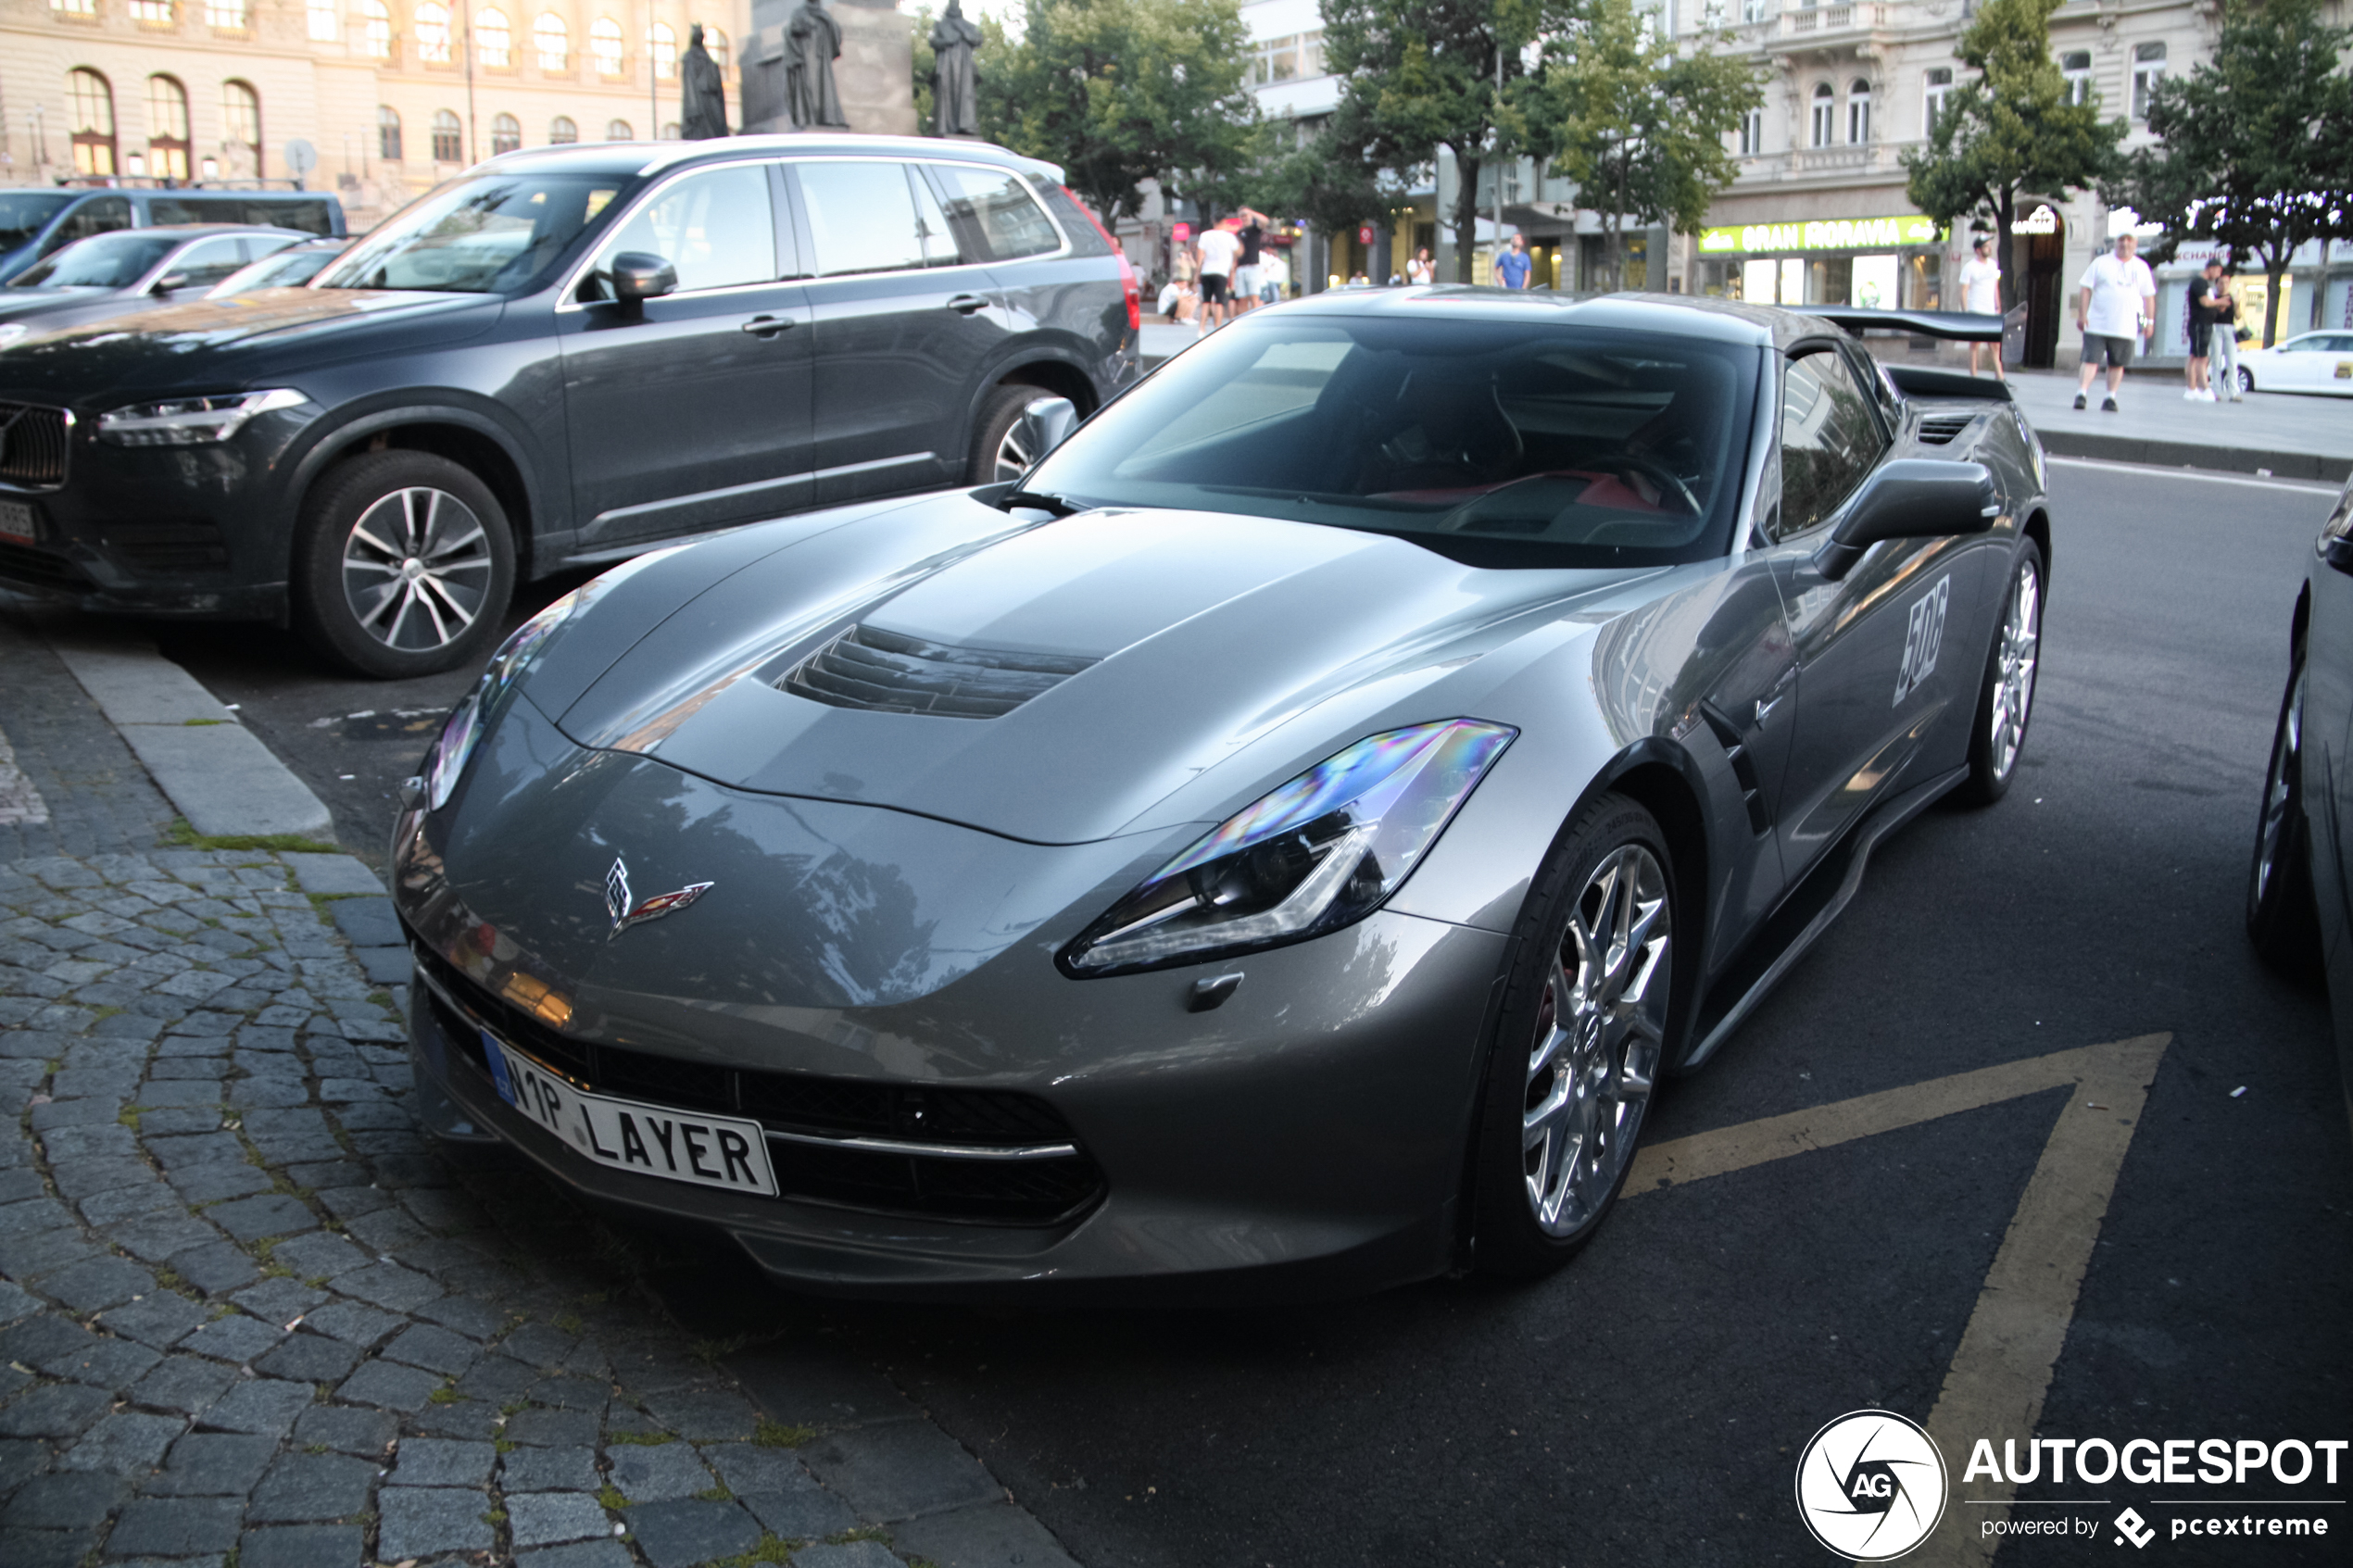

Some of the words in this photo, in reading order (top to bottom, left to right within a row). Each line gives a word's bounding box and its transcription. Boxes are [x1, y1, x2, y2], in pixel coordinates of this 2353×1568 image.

[1742, 224, 1799, 252] GRAN
[1805, 218, 1900, 249] MORAVIA
[1894, 575, 1949, 699] 506
[496, 1076, 511, 1097] CZ
[503, 1054, 561, 1130] N1P
[580, 1103, 759, 1185] LAYER
